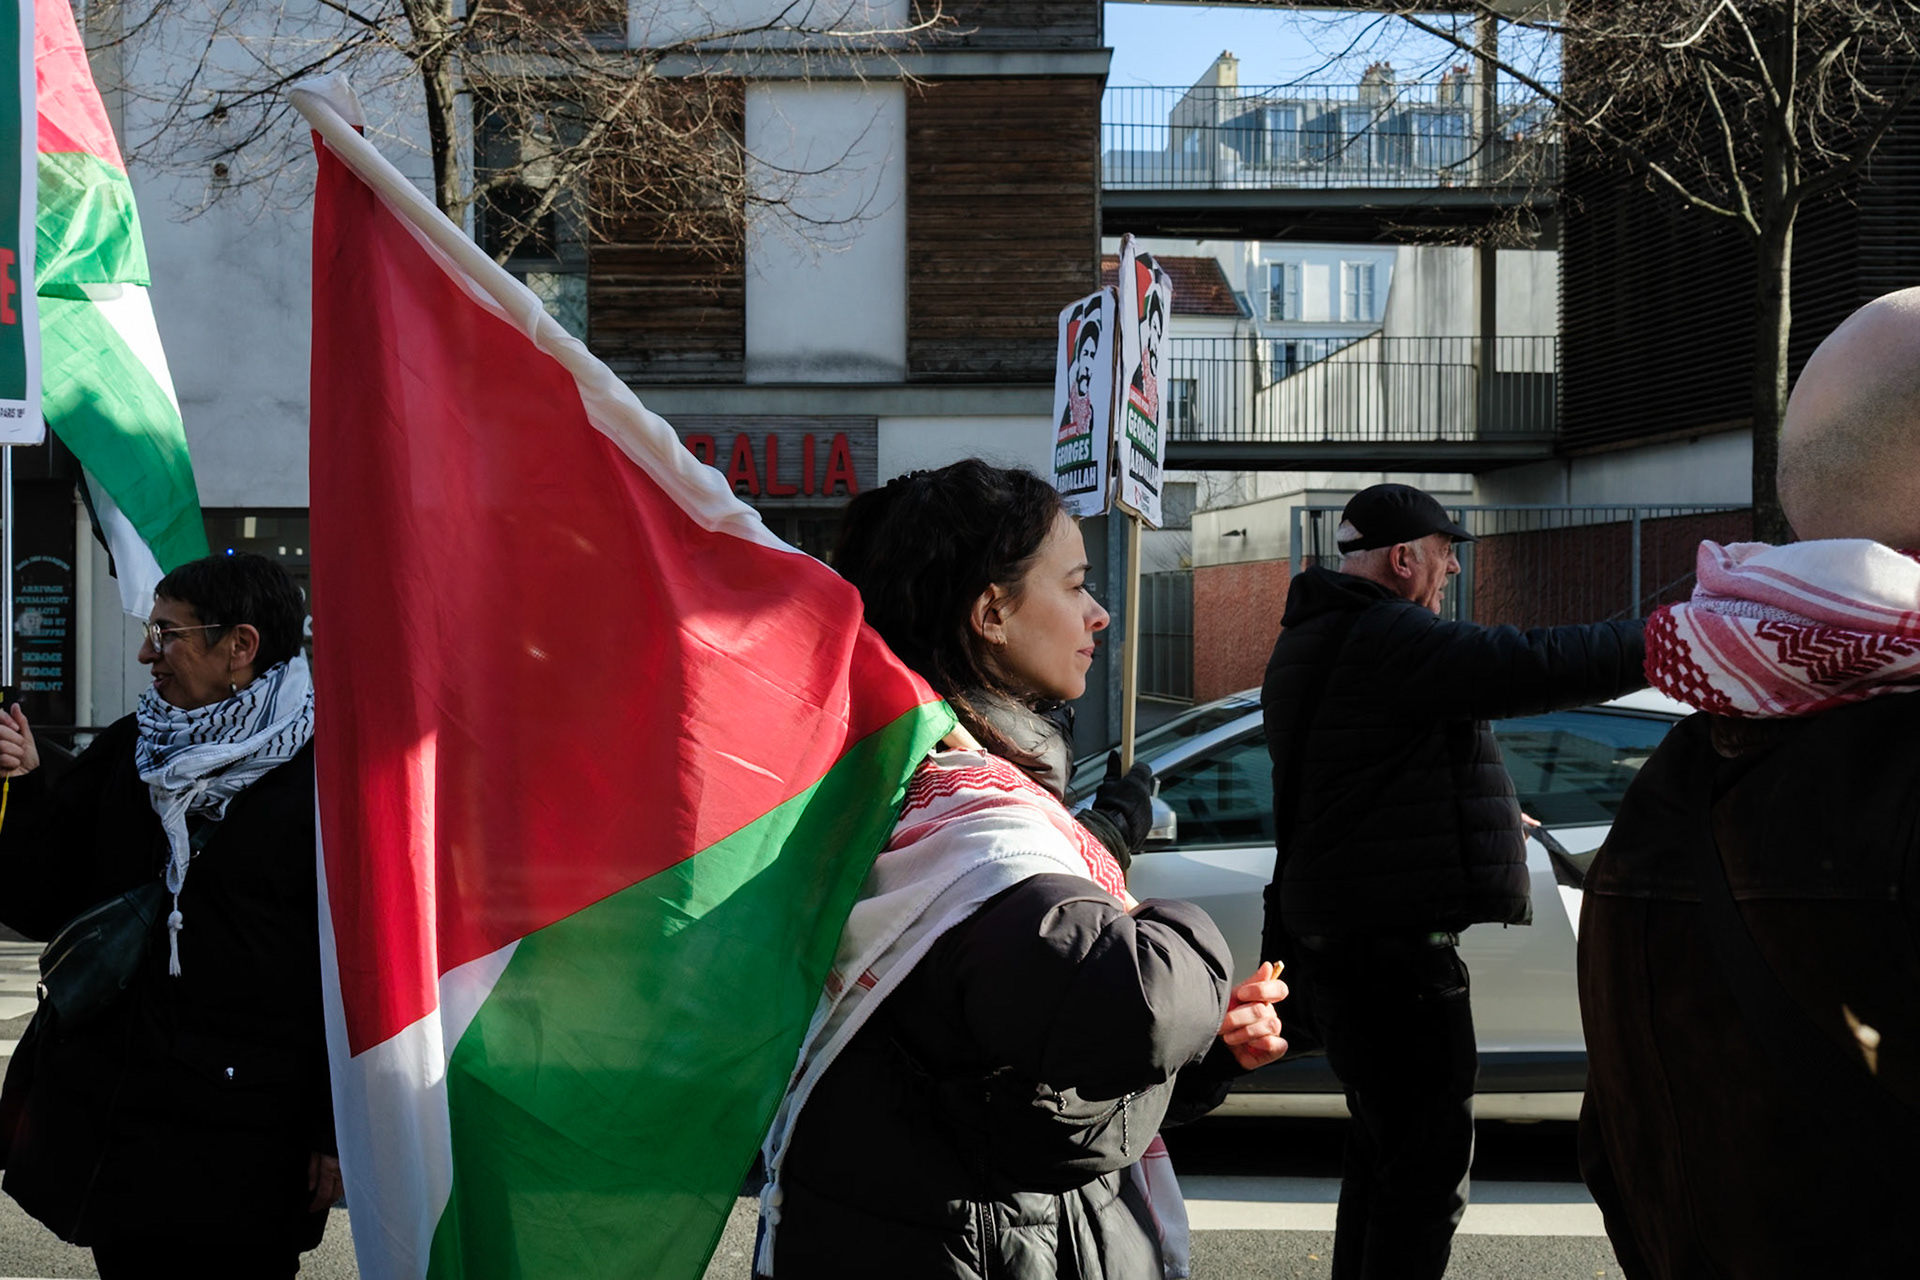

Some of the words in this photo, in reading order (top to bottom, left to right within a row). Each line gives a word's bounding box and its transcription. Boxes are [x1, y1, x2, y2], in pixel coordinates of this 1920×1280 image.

[1128, 407, 1157, 456] GEORGES
[1056, 438, 1090, 469] GEORGES
[22, 667, 62, 677] FEMME
[20, 681, 63, 691] ENFANT
